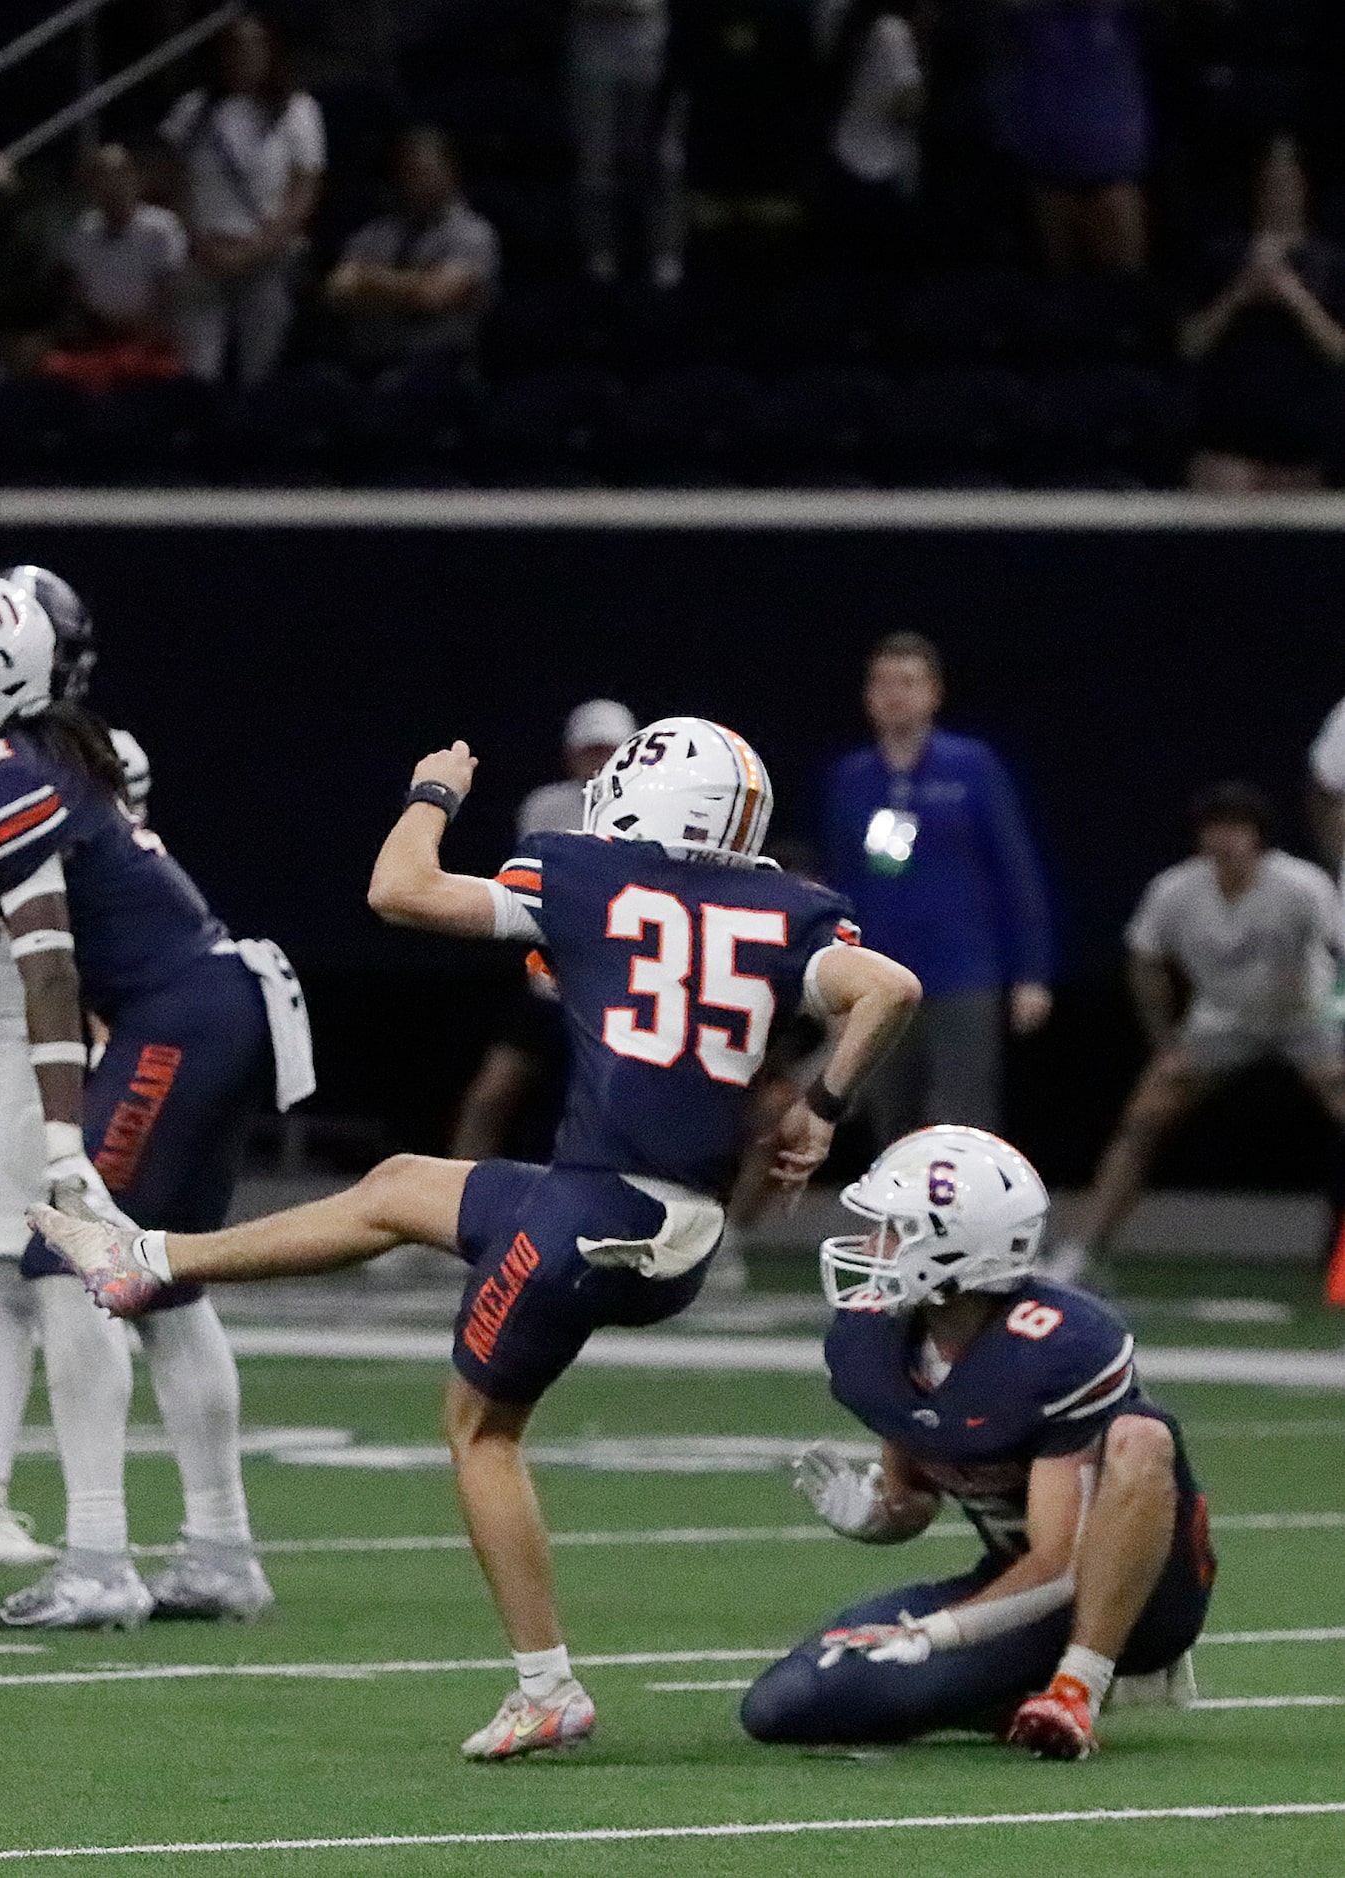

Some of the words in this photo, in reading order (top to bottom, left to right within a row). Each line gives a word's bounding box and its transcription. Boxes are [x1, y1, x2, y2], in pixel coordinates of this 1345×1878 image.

[616, 731, 678, 771] 35
[601, 883, 789, 1088] 35
[928, 1160, 958, 1207] 6
[463, 1230, 542, 1365] WAKELAND
[1006, 1299, 1064, 1342] 6
